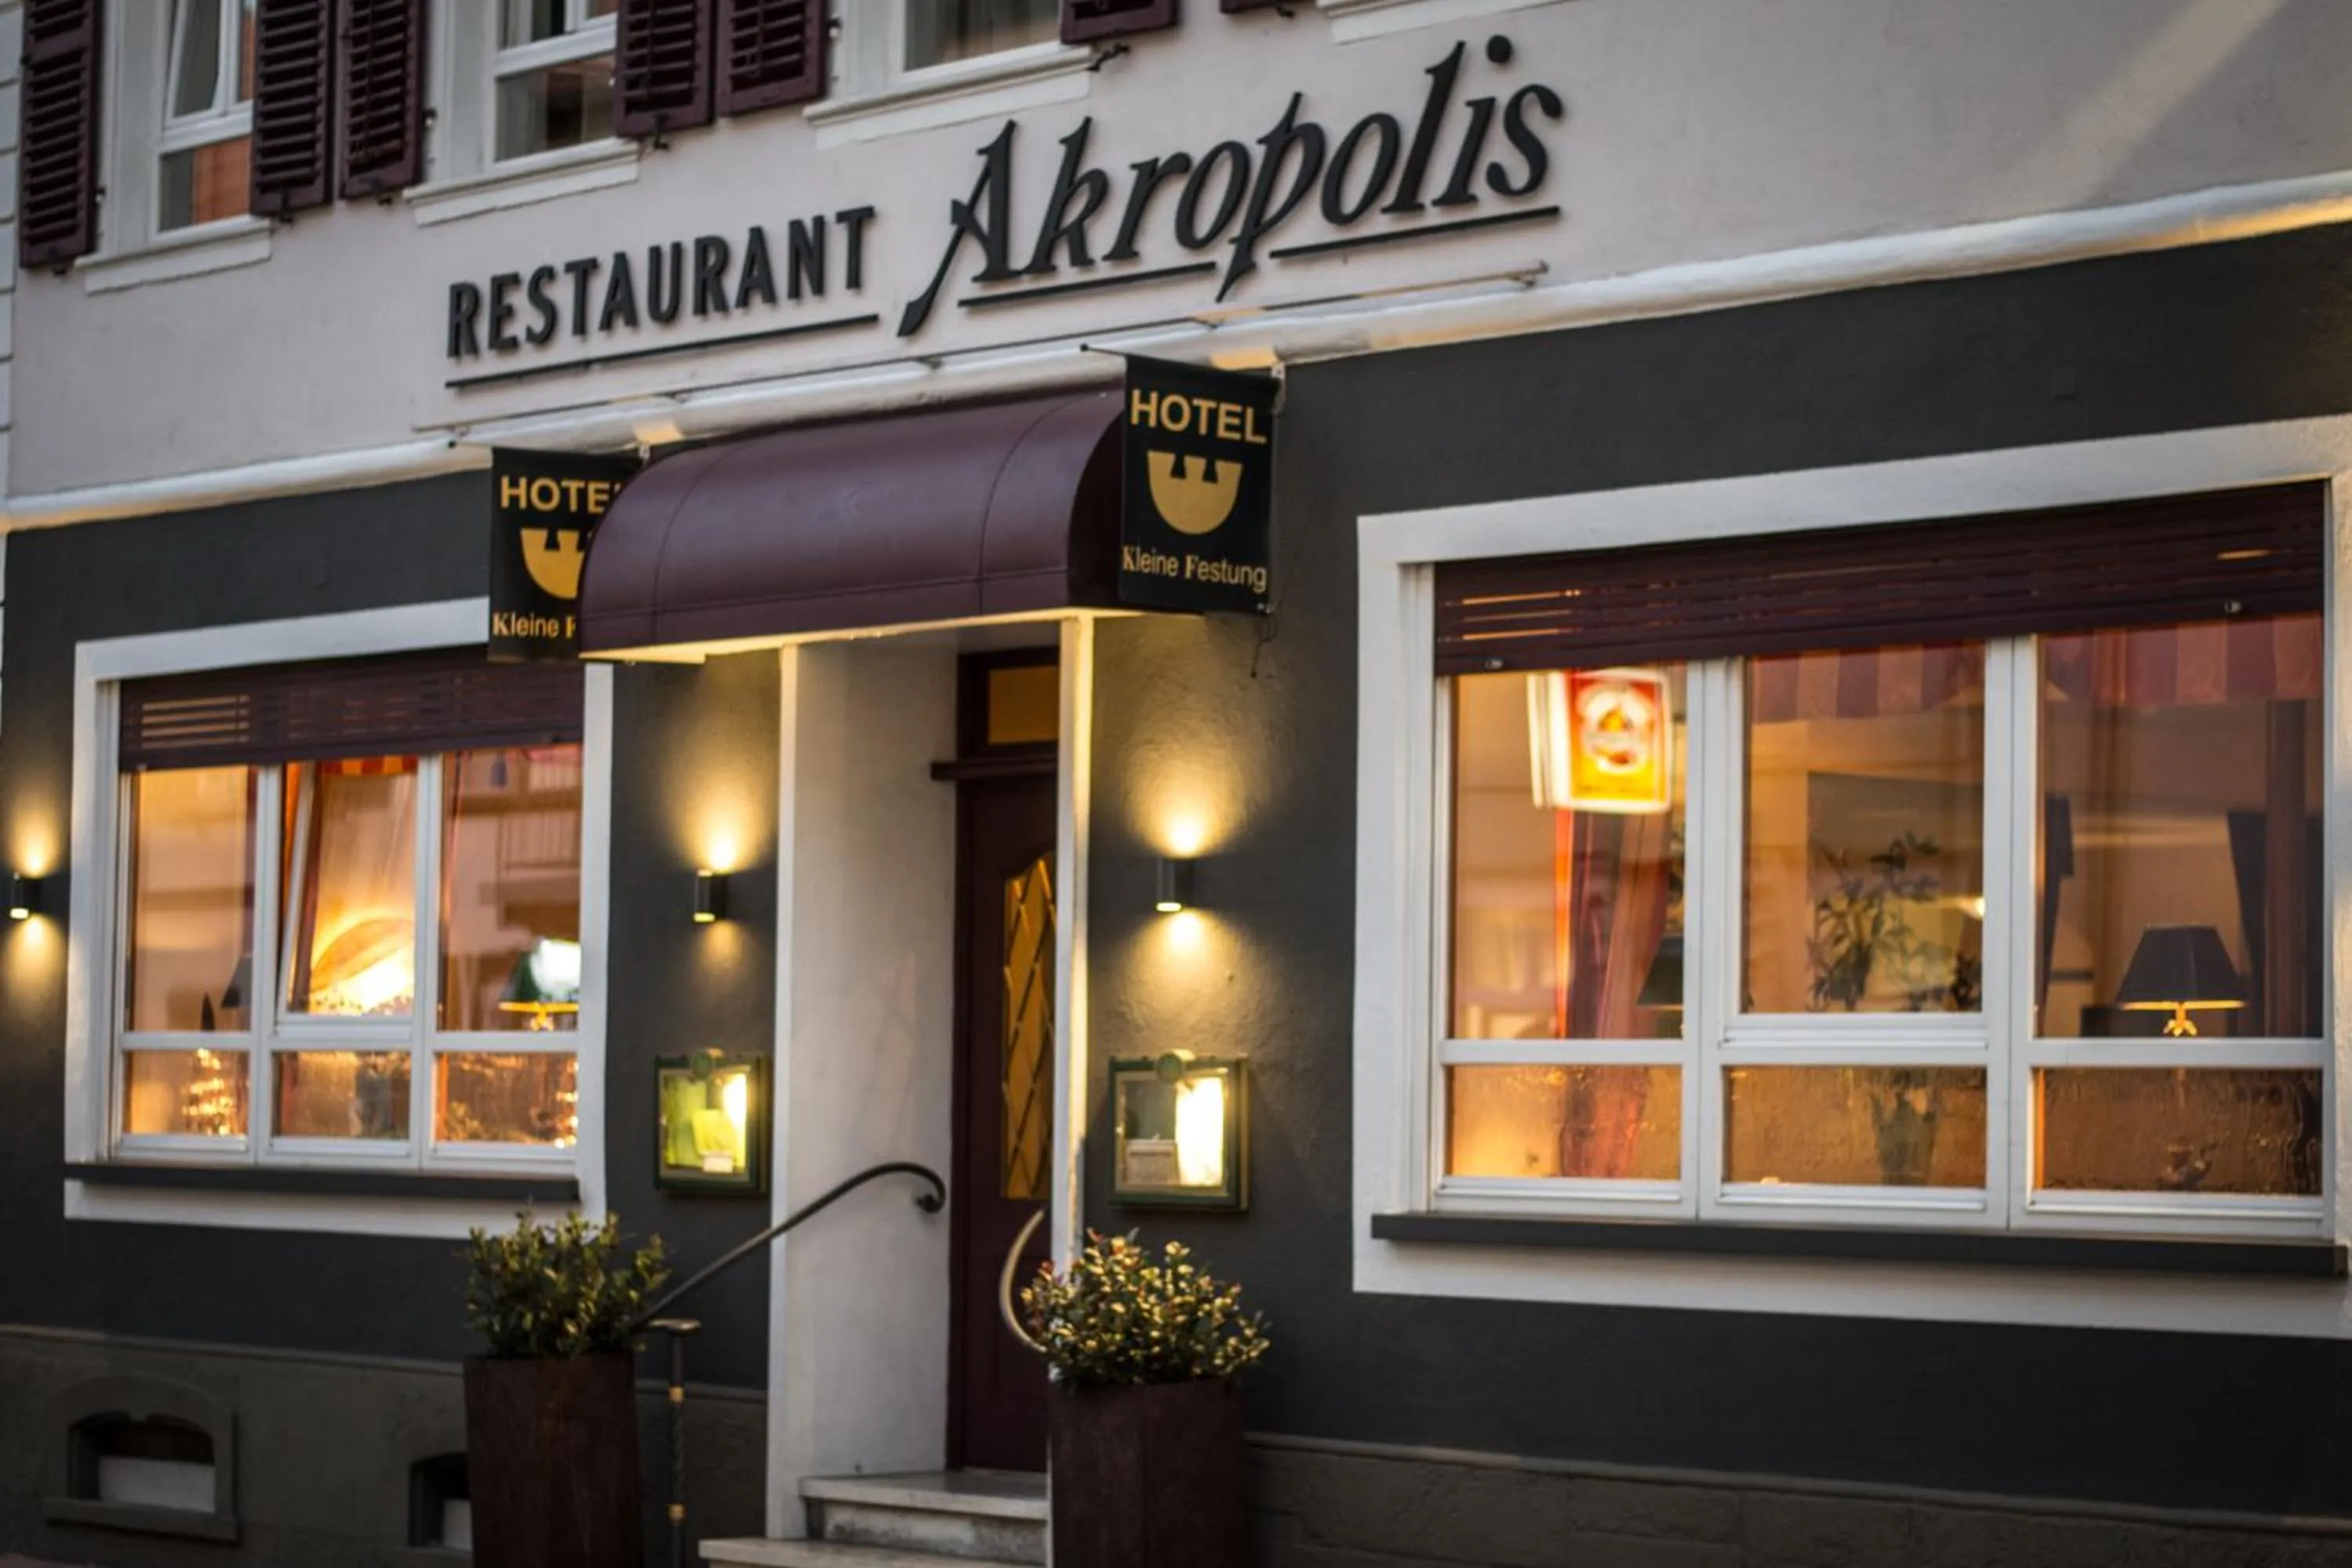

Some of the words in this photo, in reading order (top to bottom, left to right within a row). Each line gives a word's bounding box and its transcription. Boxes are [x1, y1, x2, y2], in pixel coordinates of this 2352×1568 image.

[447, 205, 877, 359] RESTAURANT
[897, 35, 1563, 337] Akropolis
[1131, 389, 1267, 444] HOTEL
[501, 475, 622, 514] HOTE
[1123, 546, 1178, 577] Kleine
[1185, 554, 1267, 593] Festung
[492, 612, 560, 637] Kleine
